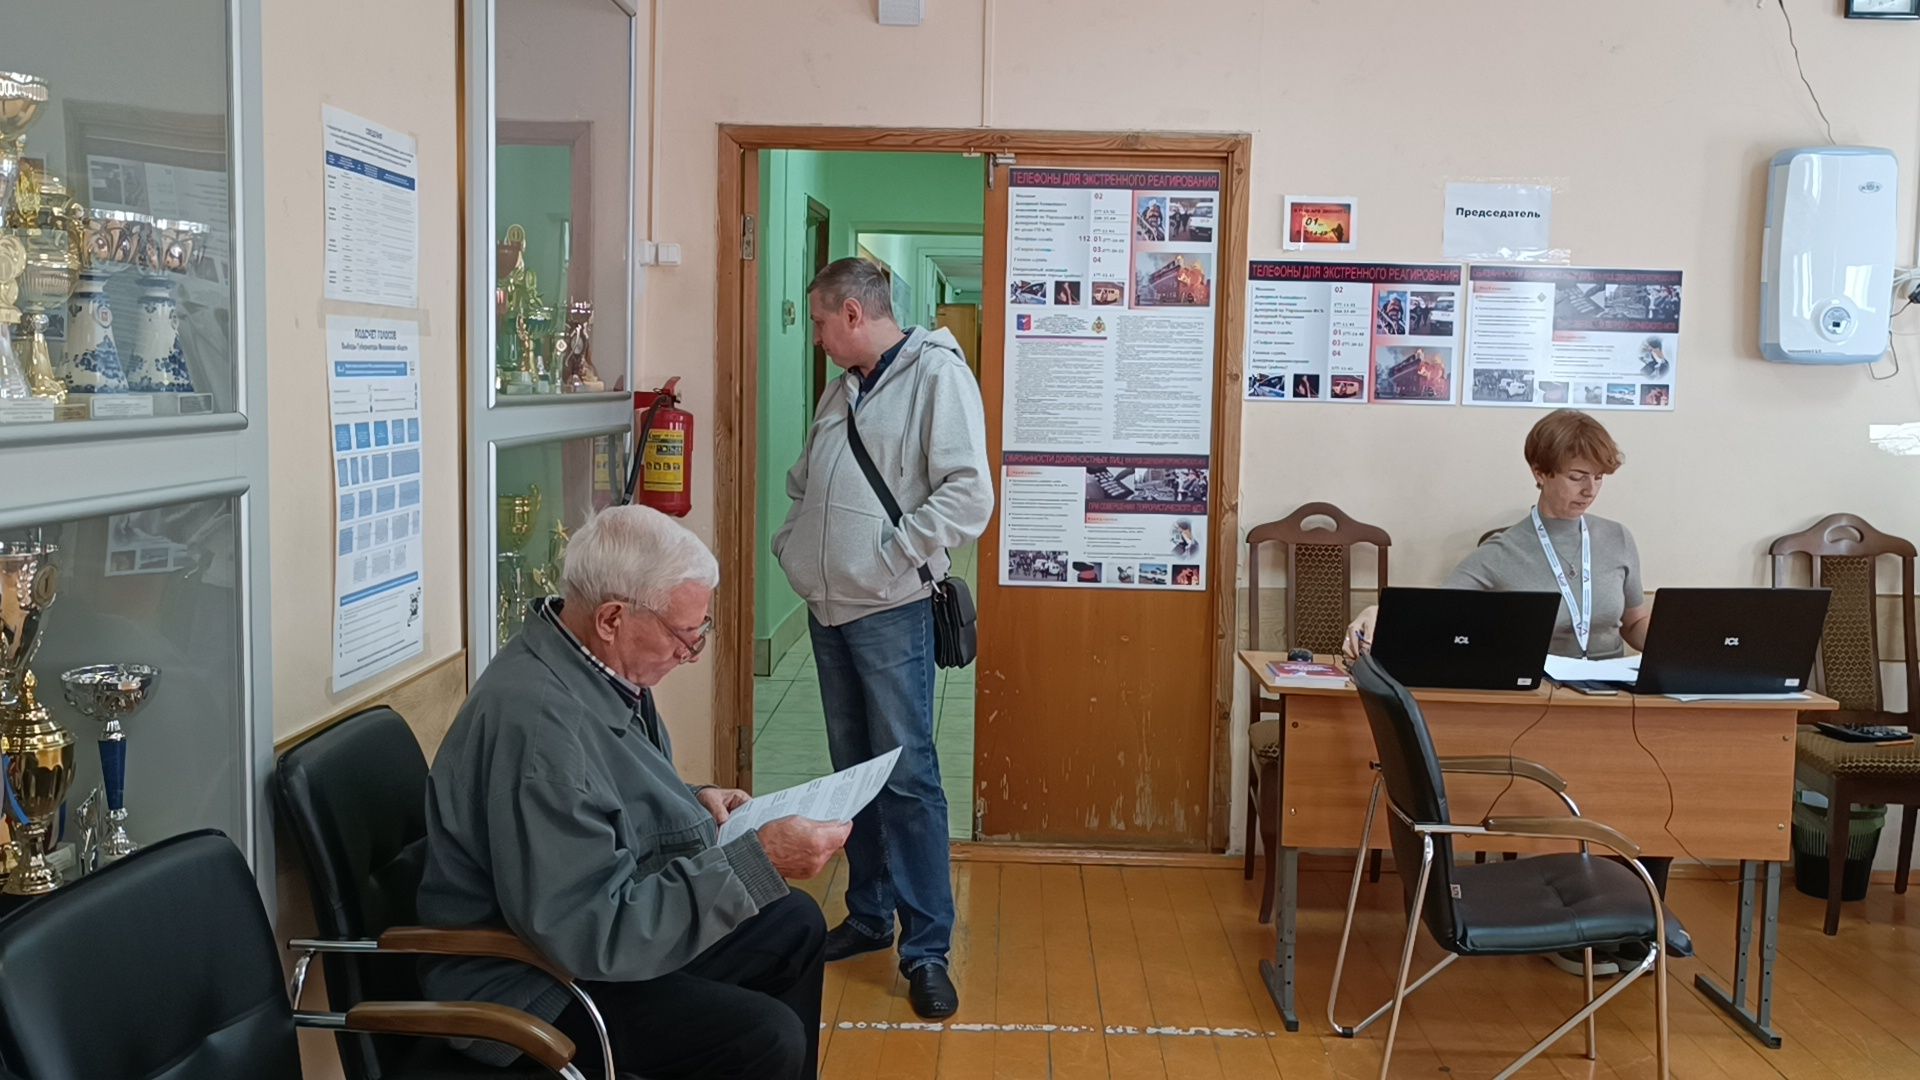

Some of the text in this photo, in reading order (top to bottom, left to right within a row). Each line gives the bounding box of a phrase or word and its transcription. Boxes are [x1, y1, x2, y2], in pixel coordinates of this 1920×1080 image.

[1012, 172, 1217, 188] ТЕЛЕФОНЫ ДЛЯ ЭКСТРЕННОГО РЕАГИРОВАНИЯ
[1455, 207, 1541, 219] Председатель
[1305, 217, 1319, 226] 01
[1252, 264, 1459, 281] ТЕЛЕФОНЫ ДЛЯ ЭКСТРЕННОГО РЕАГИРОВАНИЯ
[1454, 635, 1470, 645] ICL
[1724, 637, 1740, 646] ICL
